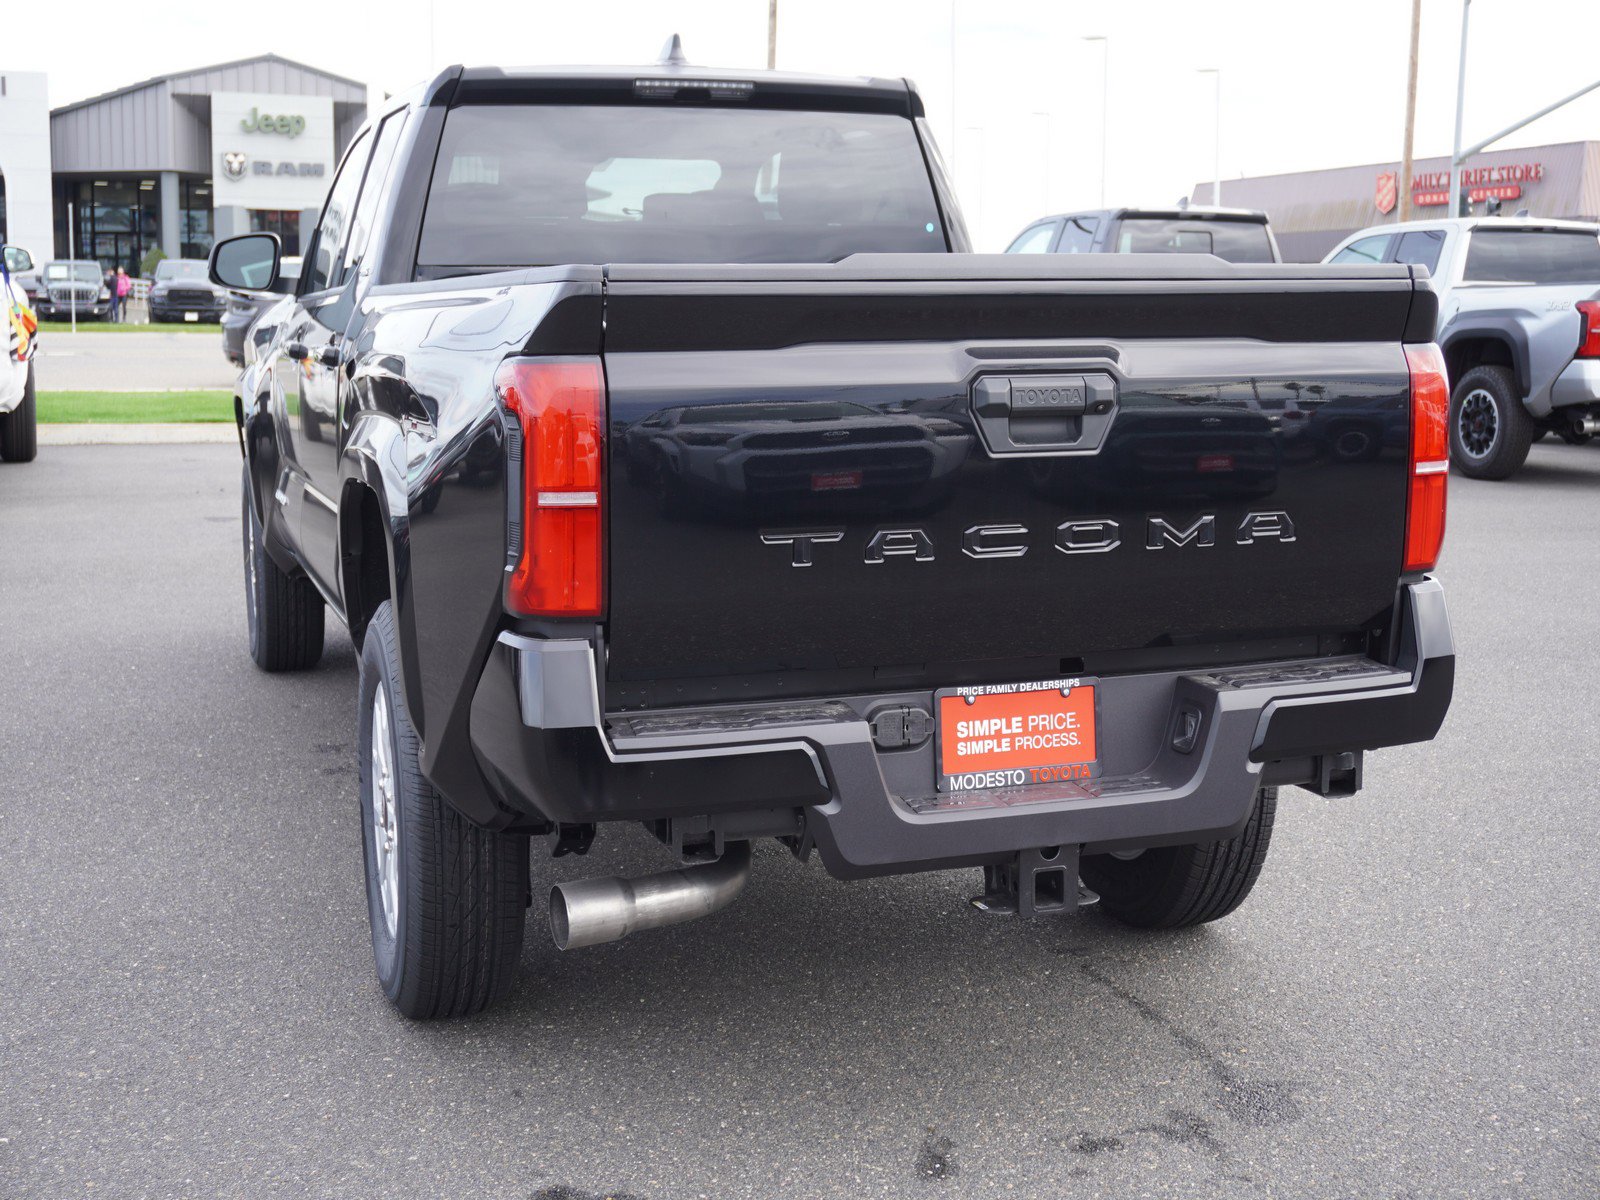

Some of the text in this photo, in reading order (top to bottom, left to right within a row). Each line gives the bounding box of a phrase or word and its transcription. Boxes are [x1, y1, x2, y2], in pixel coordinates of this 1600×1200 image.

[240, 107, 306, 139] Jeep
[252, 161, 325, 177] RAM
[1410, 170, 1442, 192] MILY
[1496, 162, 1542, 184] STORE
[1472, 187, 1513, 200] CENTER
[1015, 388, 1082, 405] TOYOTA
[760, 510, 1297, 567] TACOMA
[957, 678, 1080, 696] PRICE FAMILY DEALERSHIPS
[956, 712, 1081, 738] SIMPLE PRICE.
[957, 732, 1082, 756] SIMPLE PROCESS.
[950, 764, 1091, 790] MODESTO TOYOTA
